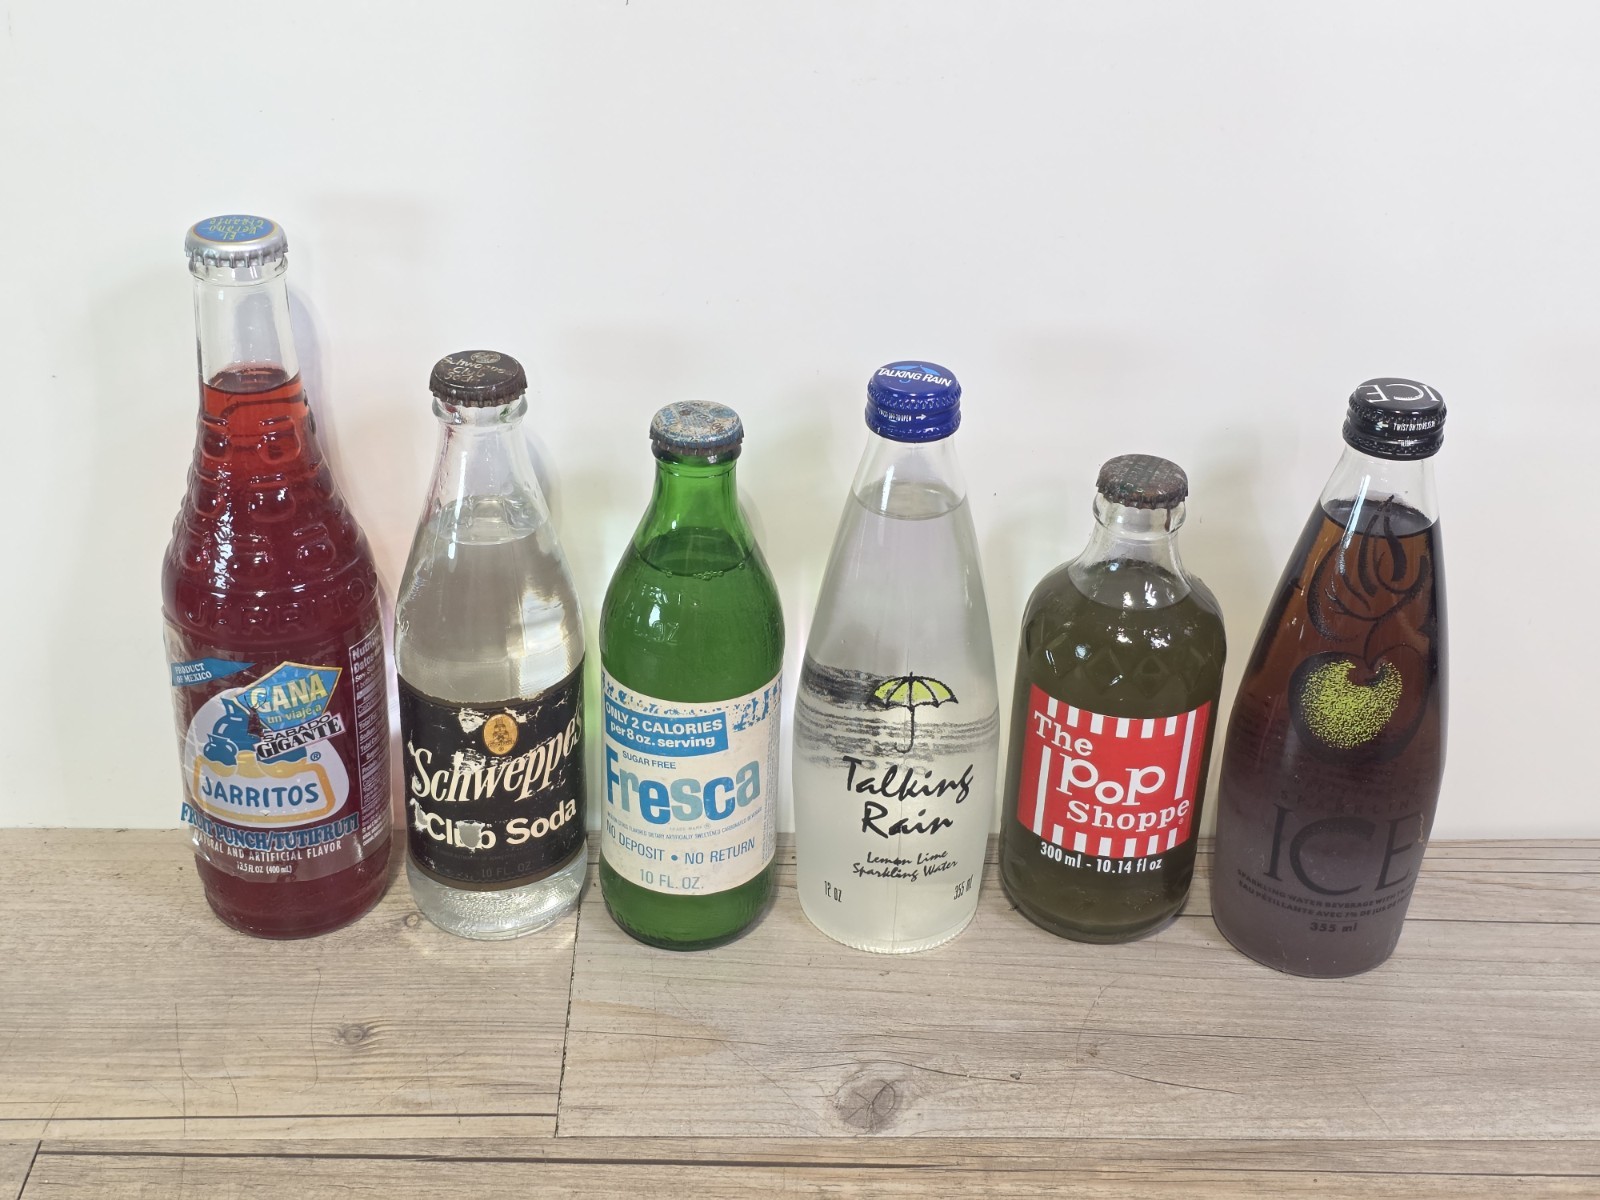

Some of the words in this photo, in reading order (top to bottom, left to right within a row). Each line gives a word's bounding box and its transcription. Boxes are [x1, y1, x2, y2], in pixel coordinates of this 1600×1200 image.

[209, 225, 257, 235] Verano
[878, 368, 922, 380] TALKING
[922, 374, 952, 387] RAIN
[1357, 383, 1439, 404] ICE
[175, 663, 205, 675] PRODUCT
[184, 671, 212, 683] MEXICO
[267, 715, 282, 724] un
[285, 707, 312, 721] viaje
[314, 704, 322, 712] a
[606, 703, 629, 725] ONLY
[631, 717, 640, 730] 2
[642, 718, 723, 735] CALORIES
[256, 717, 342, 758] GIGANTE
[262, 714, 331, 742] SABADO
[610, 721, 626, 738] per
[626, 728, 635, 740] 8
[635, 732, 656, 748] oz.
[657, 735, 716, 748] serving
[1033, 710, 1094, 757] The
[411, 708, 582, 803] Schweppes
[622, 750, 650, 767] SUGAR
[651, 760, 677, 770] FREE
[605, 743, 761, 825] Fresca
[842, 755, 975, 804] Talking
[202, 777, 319, 808] JARRITOS
[180, 802, 213, 837] FRUIT
[506, 798, 576, 846] Soda
[861, 800, 954, 839] Rain
[1066, 799, 1190, 833] Shoppe
[226, 847, 245, 859] AND
[248, 851, 303, 862] ARTIFICIAL
[306, 840, 342, 859] FLAVOR
[606, 818, 616, 839] NO
[618, 831, 665, 862] DEPOSIT
[684, 852, 704, 866] NO
[709, 837, 756, 863] RETURN
[1263, 802, 1423, 896] ICE
[866, 851, 913, 866] Lemon
[916, 851, 949, 865] Lime
[1040, 841, 1062, 862] 300
[1064, 855, 1081, 869] ml
[1097, 858, 1132, 874] 10.14
[1136, 858, 1147, 872] fl
[1149, 857, 1163, 872] oz
[639, 868, 654, 885] 10
[659, 874, 678, 889] FL.
[682, 877, 705, 890] OZ.
[852, 862, 919, 882] Sparkling
[923, 860, 959, 877] Water
[824, 880, 832, 898] 12
[953, 880, 965, 901] 355
[1287, 894, 1323, 907] WATER
[1324, 900, 1374, 909] BEVERAGE
[1315, 910, 1343, 919] AVEC
[1360, 909, 1371, 917] DE
[1309, 921, 1337, 933] 355
[1341, 922, 1358, 933] ml
